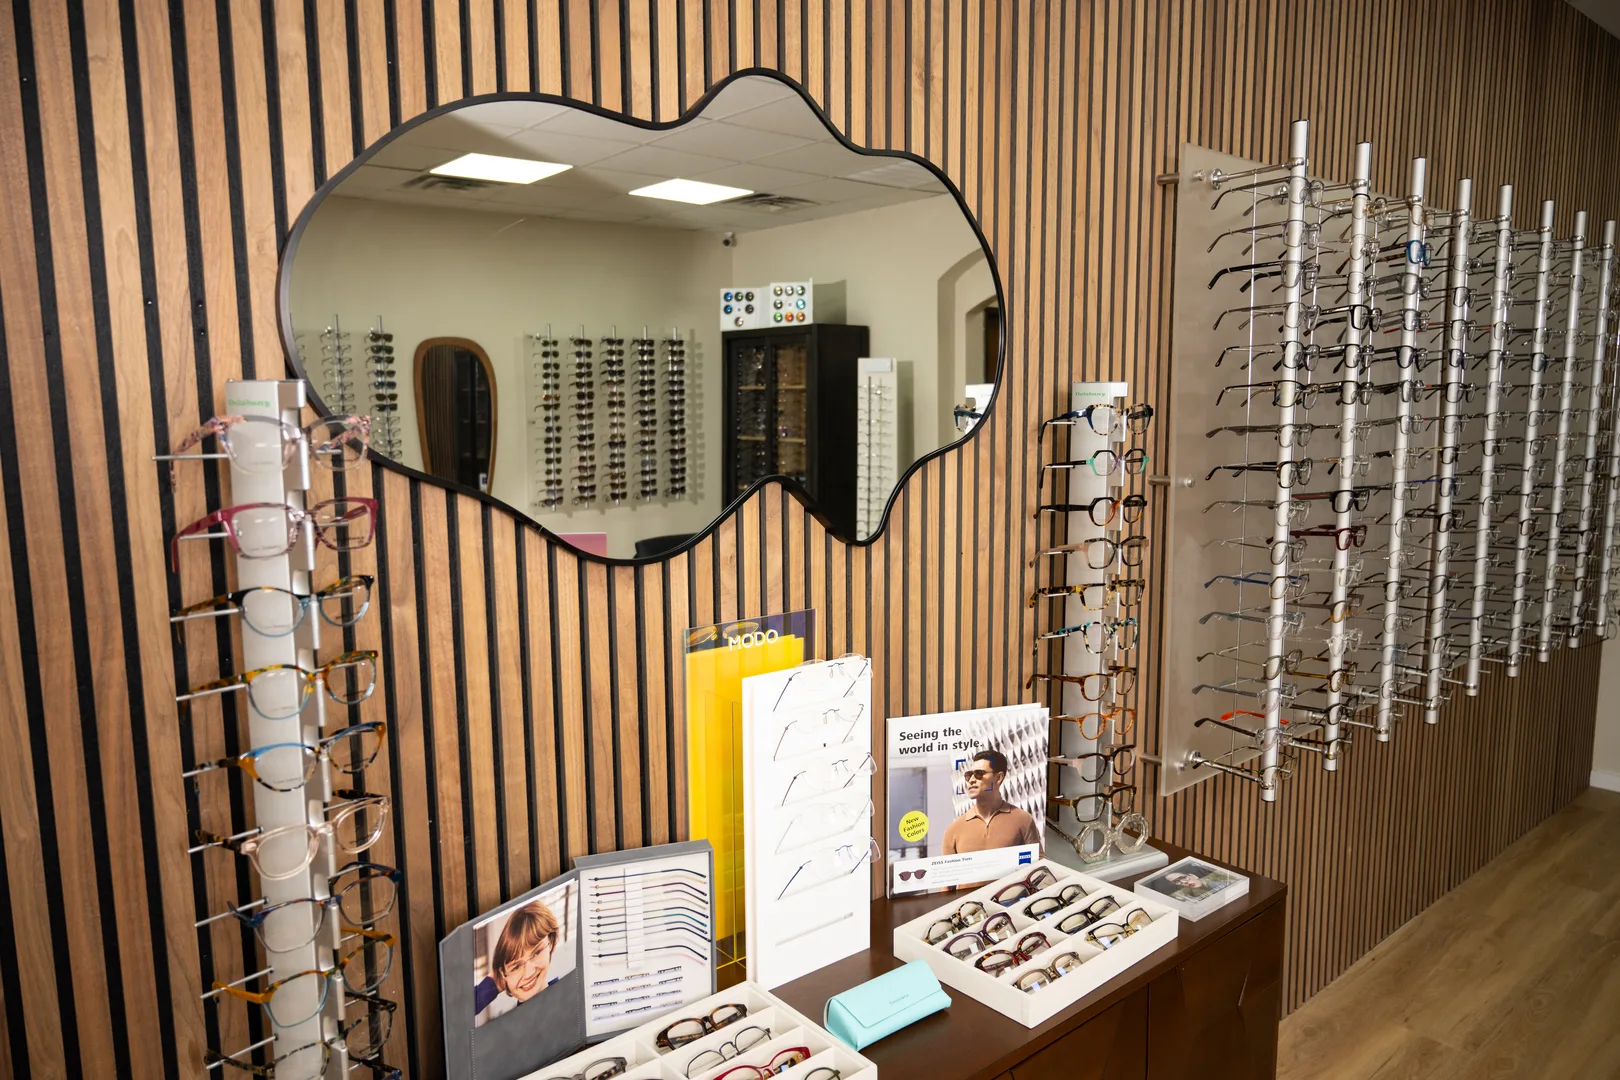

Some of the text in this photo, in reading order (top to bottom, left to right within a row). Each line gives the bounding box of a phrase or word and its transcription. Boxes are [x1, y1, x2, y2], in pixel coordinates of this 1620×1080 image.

[729, 629, 779, 651] MODO
[899, 727, 962, 741] Seeing the
[899, 738, 984, 755] world in style.
[903, 820, 926, 833] Fashion
[905, 816, 919, 825] New
[906, 828, 925, 838] Colors
